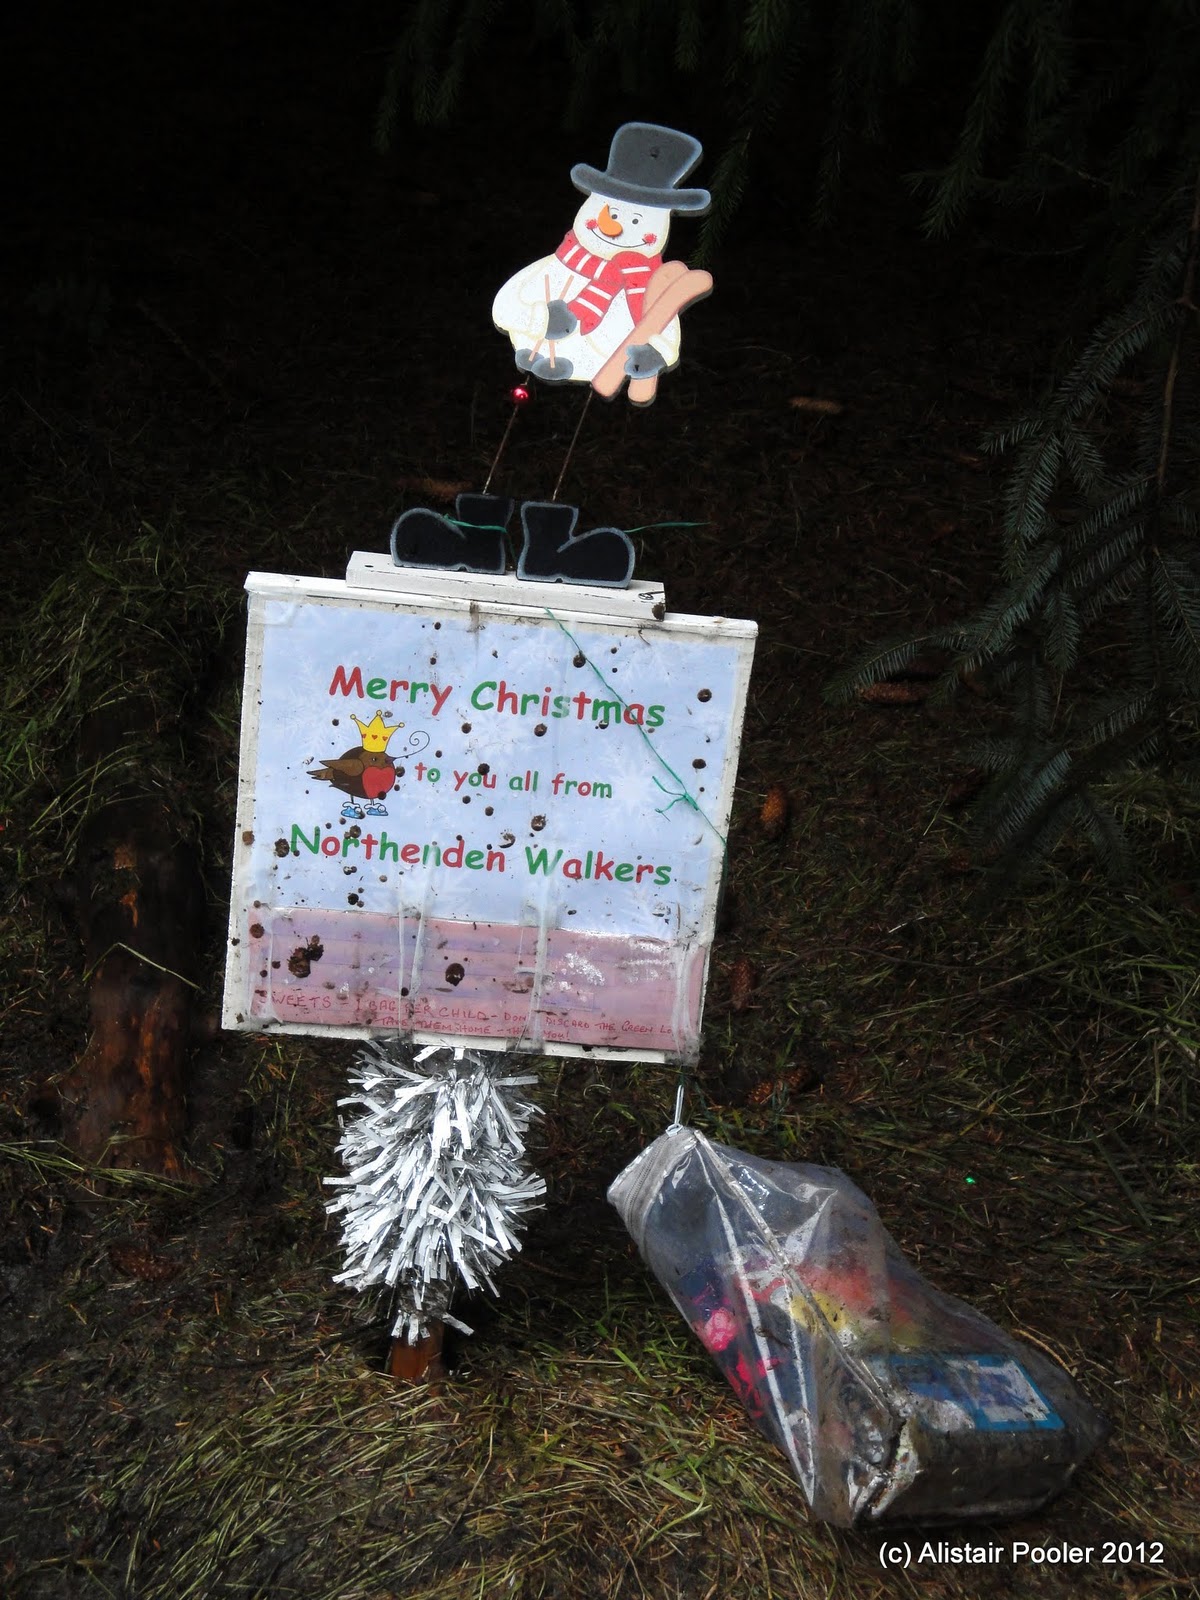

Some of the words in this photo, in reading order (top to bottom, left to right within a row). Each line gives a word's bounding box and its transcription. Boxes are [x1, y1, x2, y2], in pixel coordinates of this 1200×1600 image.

[329, 665, 453, 716] Merry
[470, 680, 666, 727] Christmas
[414, 762, 441, 783] to
[453, 770, 497, 792] you
[509, 770, 539, 792] all
[551, 772, 613, 799] from
[290, 823, 506, 873] Northenden
[525, 846, 672, 885] Walkers
[258, 994, 332, 1009] WEETS
[368, 999, 398, 1012] BAG
[594, 1021, 617, 1032] THE
